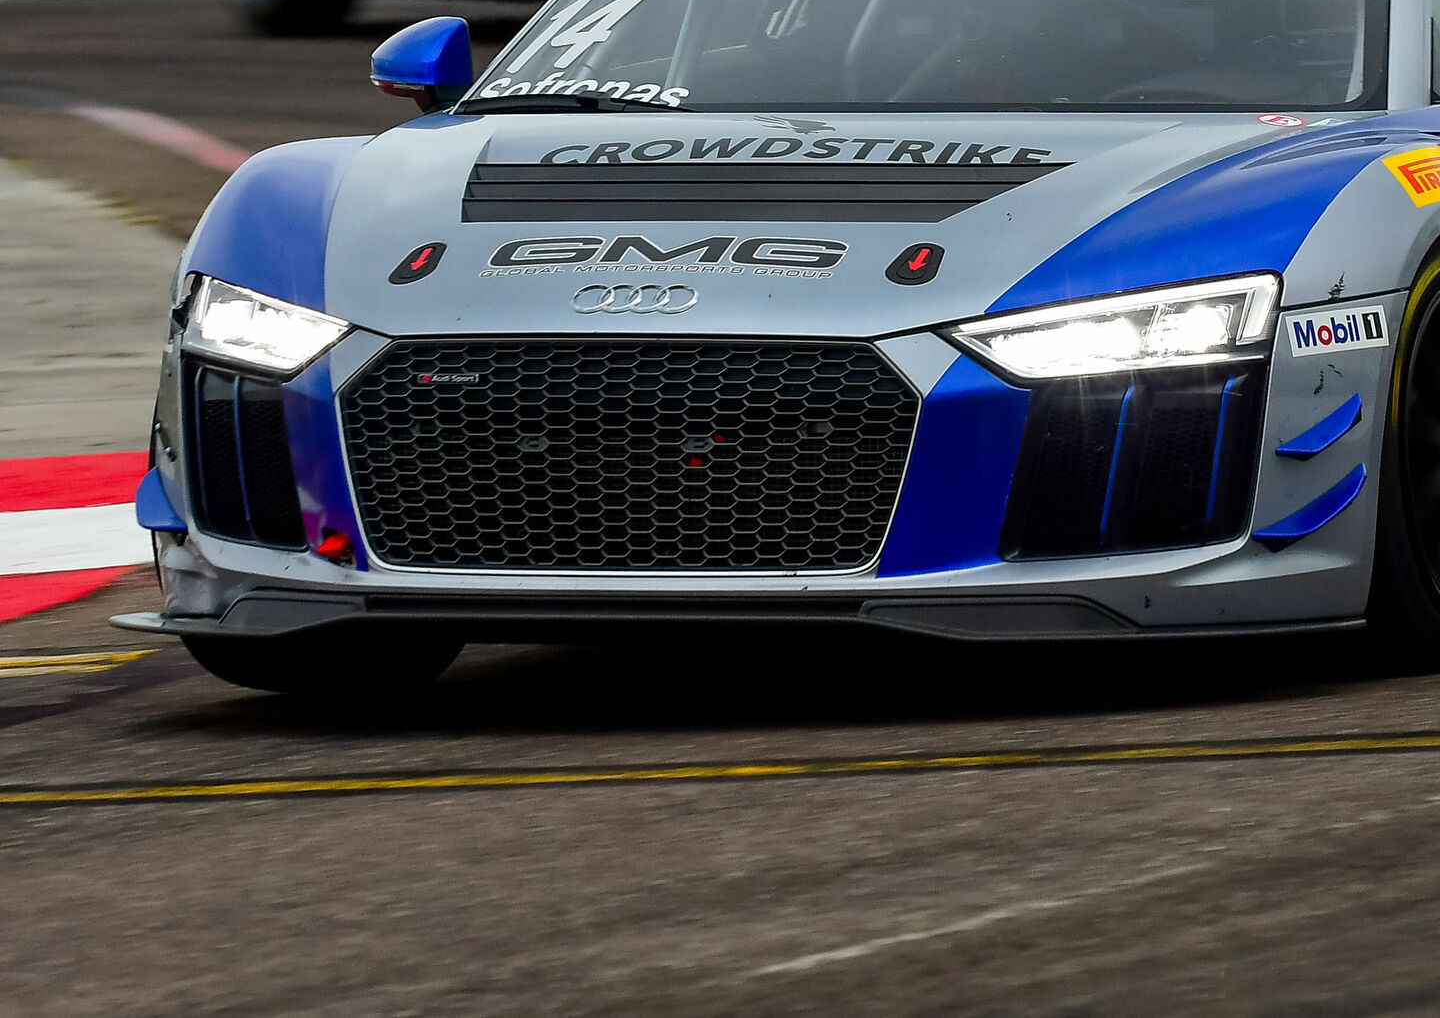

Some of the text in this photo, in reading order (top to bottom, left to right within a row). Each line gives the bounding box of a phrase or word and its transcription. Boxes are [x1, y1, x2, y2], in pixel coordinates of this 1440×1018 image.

[540, 136, 1054, 165] CROWDSTRIKE
[487, 235, 851, 268] GMG
[480, 264, 834, 280] GLOBAL MOTORSPORTS GROUP
[1291, 313, 1383, 349] Mobil 1
